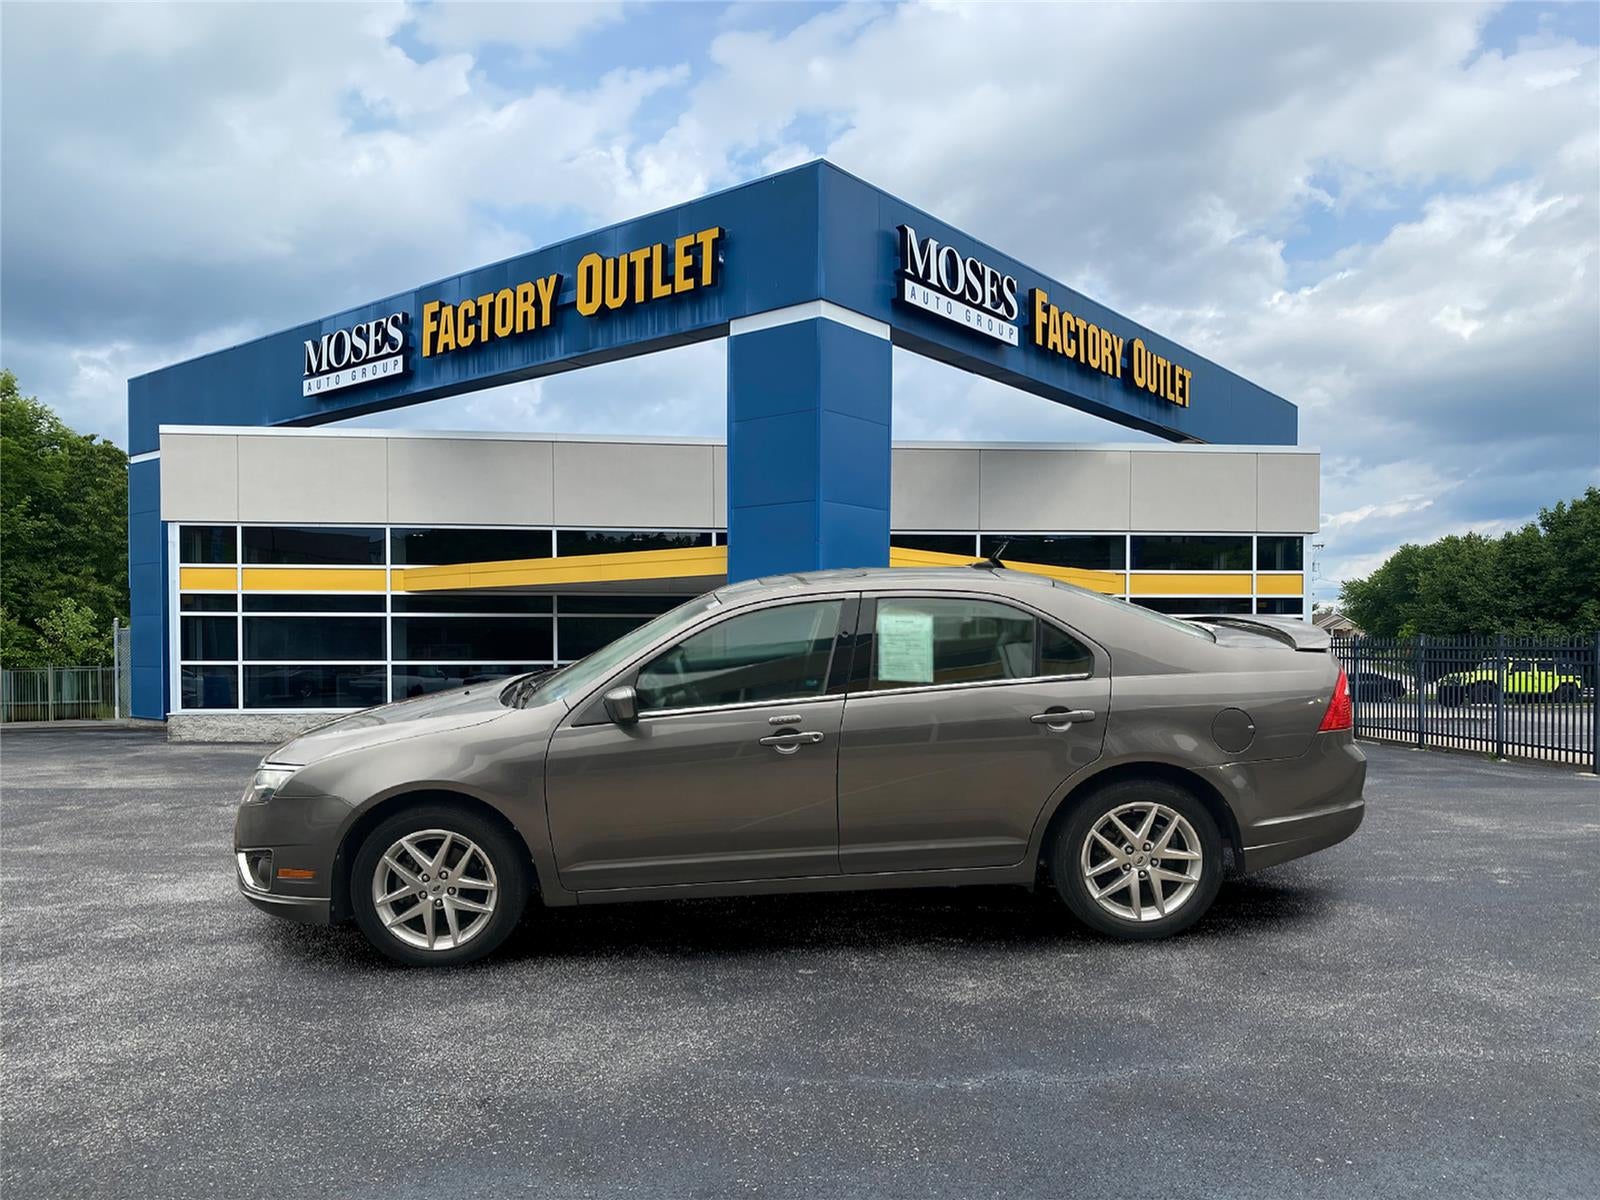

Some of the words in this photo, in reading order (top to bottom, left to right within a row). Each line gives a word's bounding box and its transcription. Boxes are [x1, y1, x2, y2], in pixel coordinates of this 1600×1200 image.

[422, 273, 559, 358] FACTORY
[576, 226, 720, 317] OUTLET
[904, 225, 1018, 321] MOSES
[909, 285, 953, 315] AUTO
[965, 308, 1015, 339] GROUP
[303, 312, 404, 375] MOSES
[307, 374, 341, 392] AUTO
[350, 359, 399, 382] GROUP
[1035, 287, 1124, 378] FACTORY
[1132, 337, 1192, 408] OUTLET
